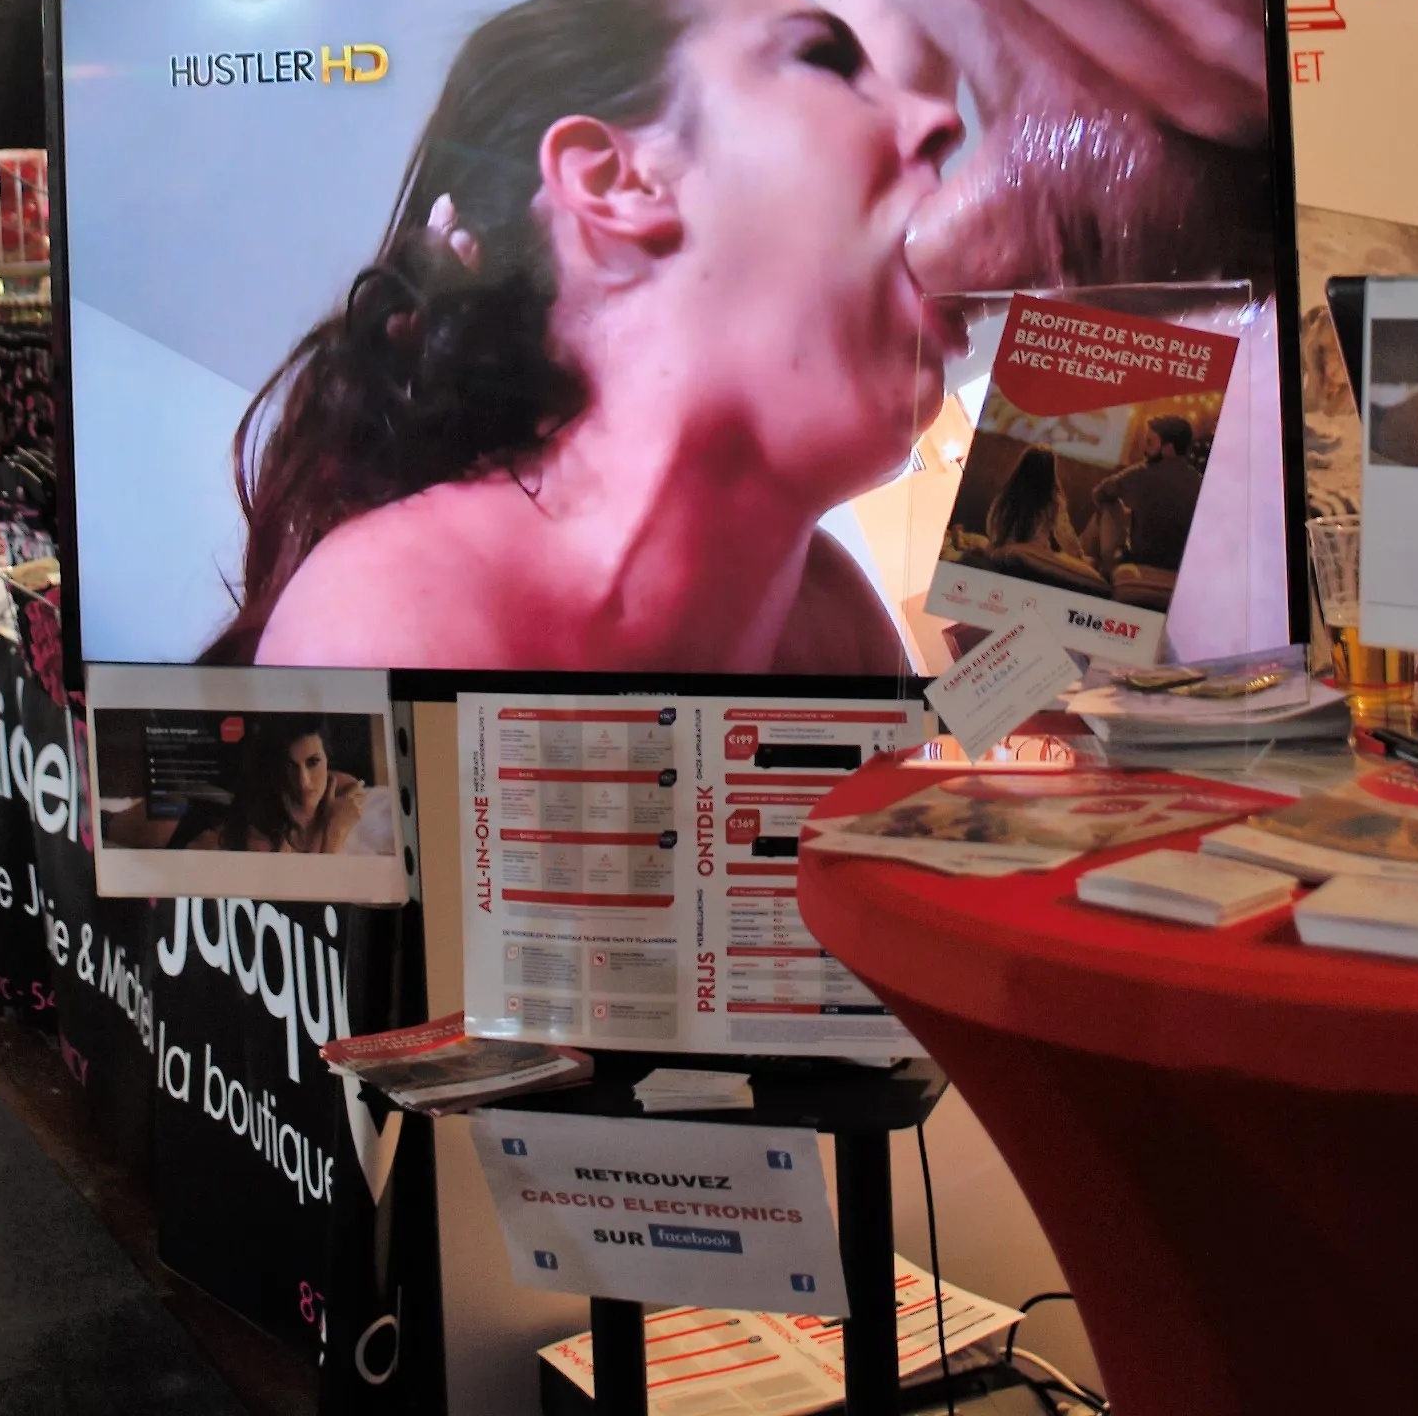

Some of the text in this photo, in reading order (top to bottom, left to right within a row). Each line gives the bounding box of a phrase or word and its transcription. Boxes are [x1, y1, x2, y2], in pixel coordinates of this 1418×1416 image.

[169, 43, 389, 88] HUSTLER HD
[1014, 328, 1208, 383] BEAUX MOMENTS TÉLÉ
[1019, 309, 1212, 363] PROFITEZ DE VOS PLUS
[1007, 349, 1127, 386] AVEC TÉLÉSAT
[473, 795, 493, 914] ALL-IN-ONE
[696, 785, 715, 877] ONTDEK
[696, 950, 716, 1013] PRIJS
[156, 1020, 190, 1103] la
[574, 1167, 732, 1190] RETROUVEZ
[521, 1189, 803, 1224] CASCIO ELECTRONICS
[593, 1228, 732, 1248] SUR facebook
